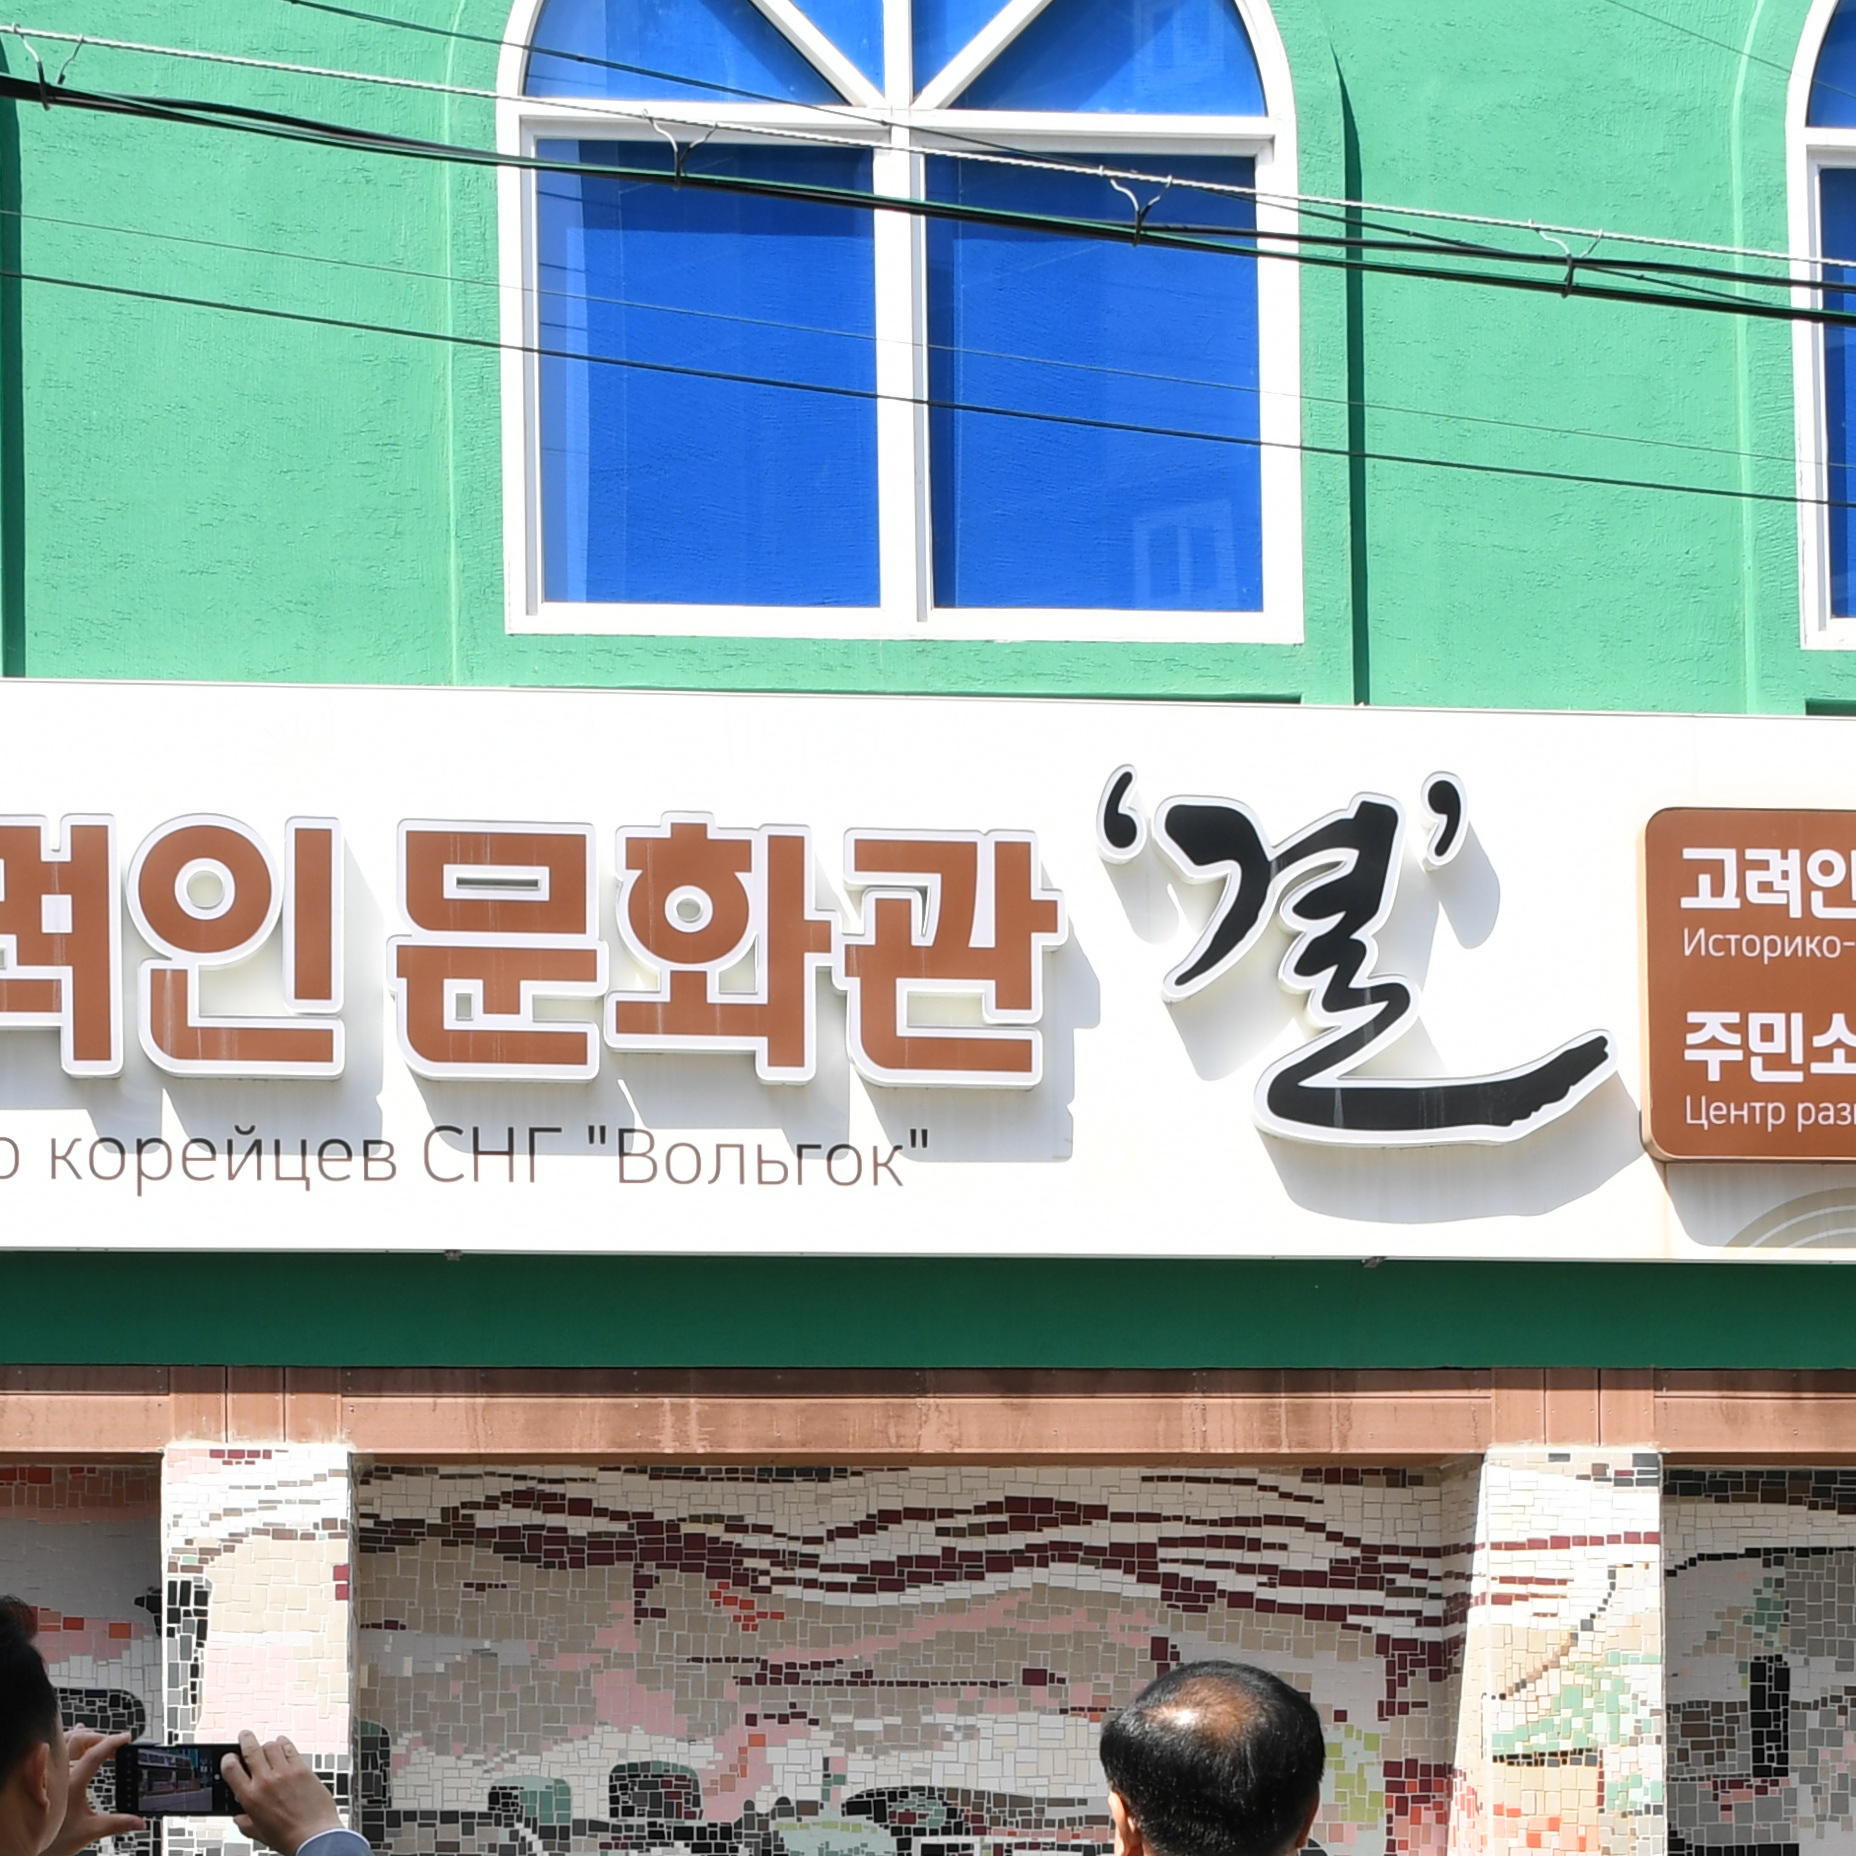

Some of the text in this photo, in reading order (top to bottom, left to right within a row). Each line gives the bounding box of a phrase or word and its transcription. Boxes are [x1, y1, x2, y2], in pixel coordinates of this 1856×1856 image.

[391, 815, 1063, 1080] 문화관
[1685, 1095, 1786, 1132] Центр
[49, 1124, 398, 1196] корейцев
[421, 1124, 564, 1184] СНГ
